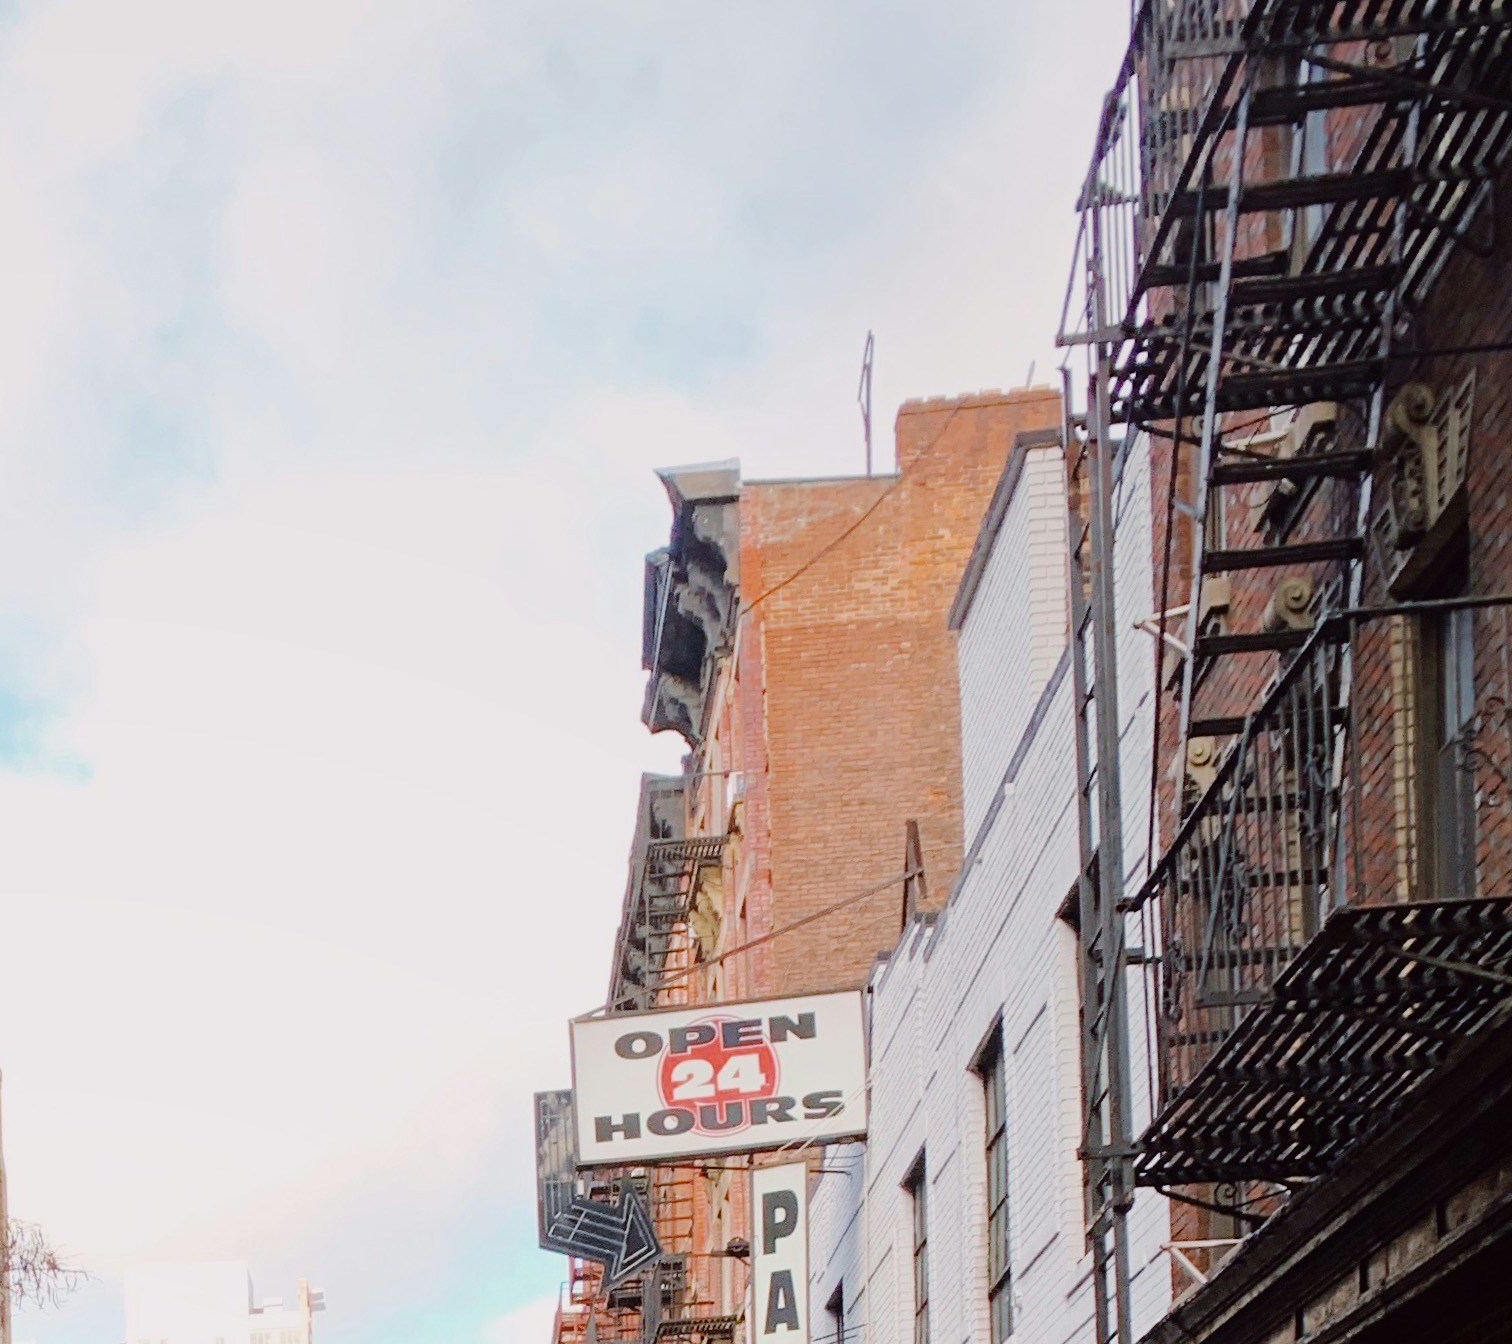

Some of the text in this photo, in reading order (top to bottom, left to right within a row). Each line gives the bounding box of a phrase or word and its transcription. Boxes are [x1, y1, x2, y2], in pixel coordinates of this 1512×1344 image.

[614, 1012, 817, 1060] OPEN
[670, 1053, 767, 1101] 24
[594, 1090, 846, 1143] HOURS
